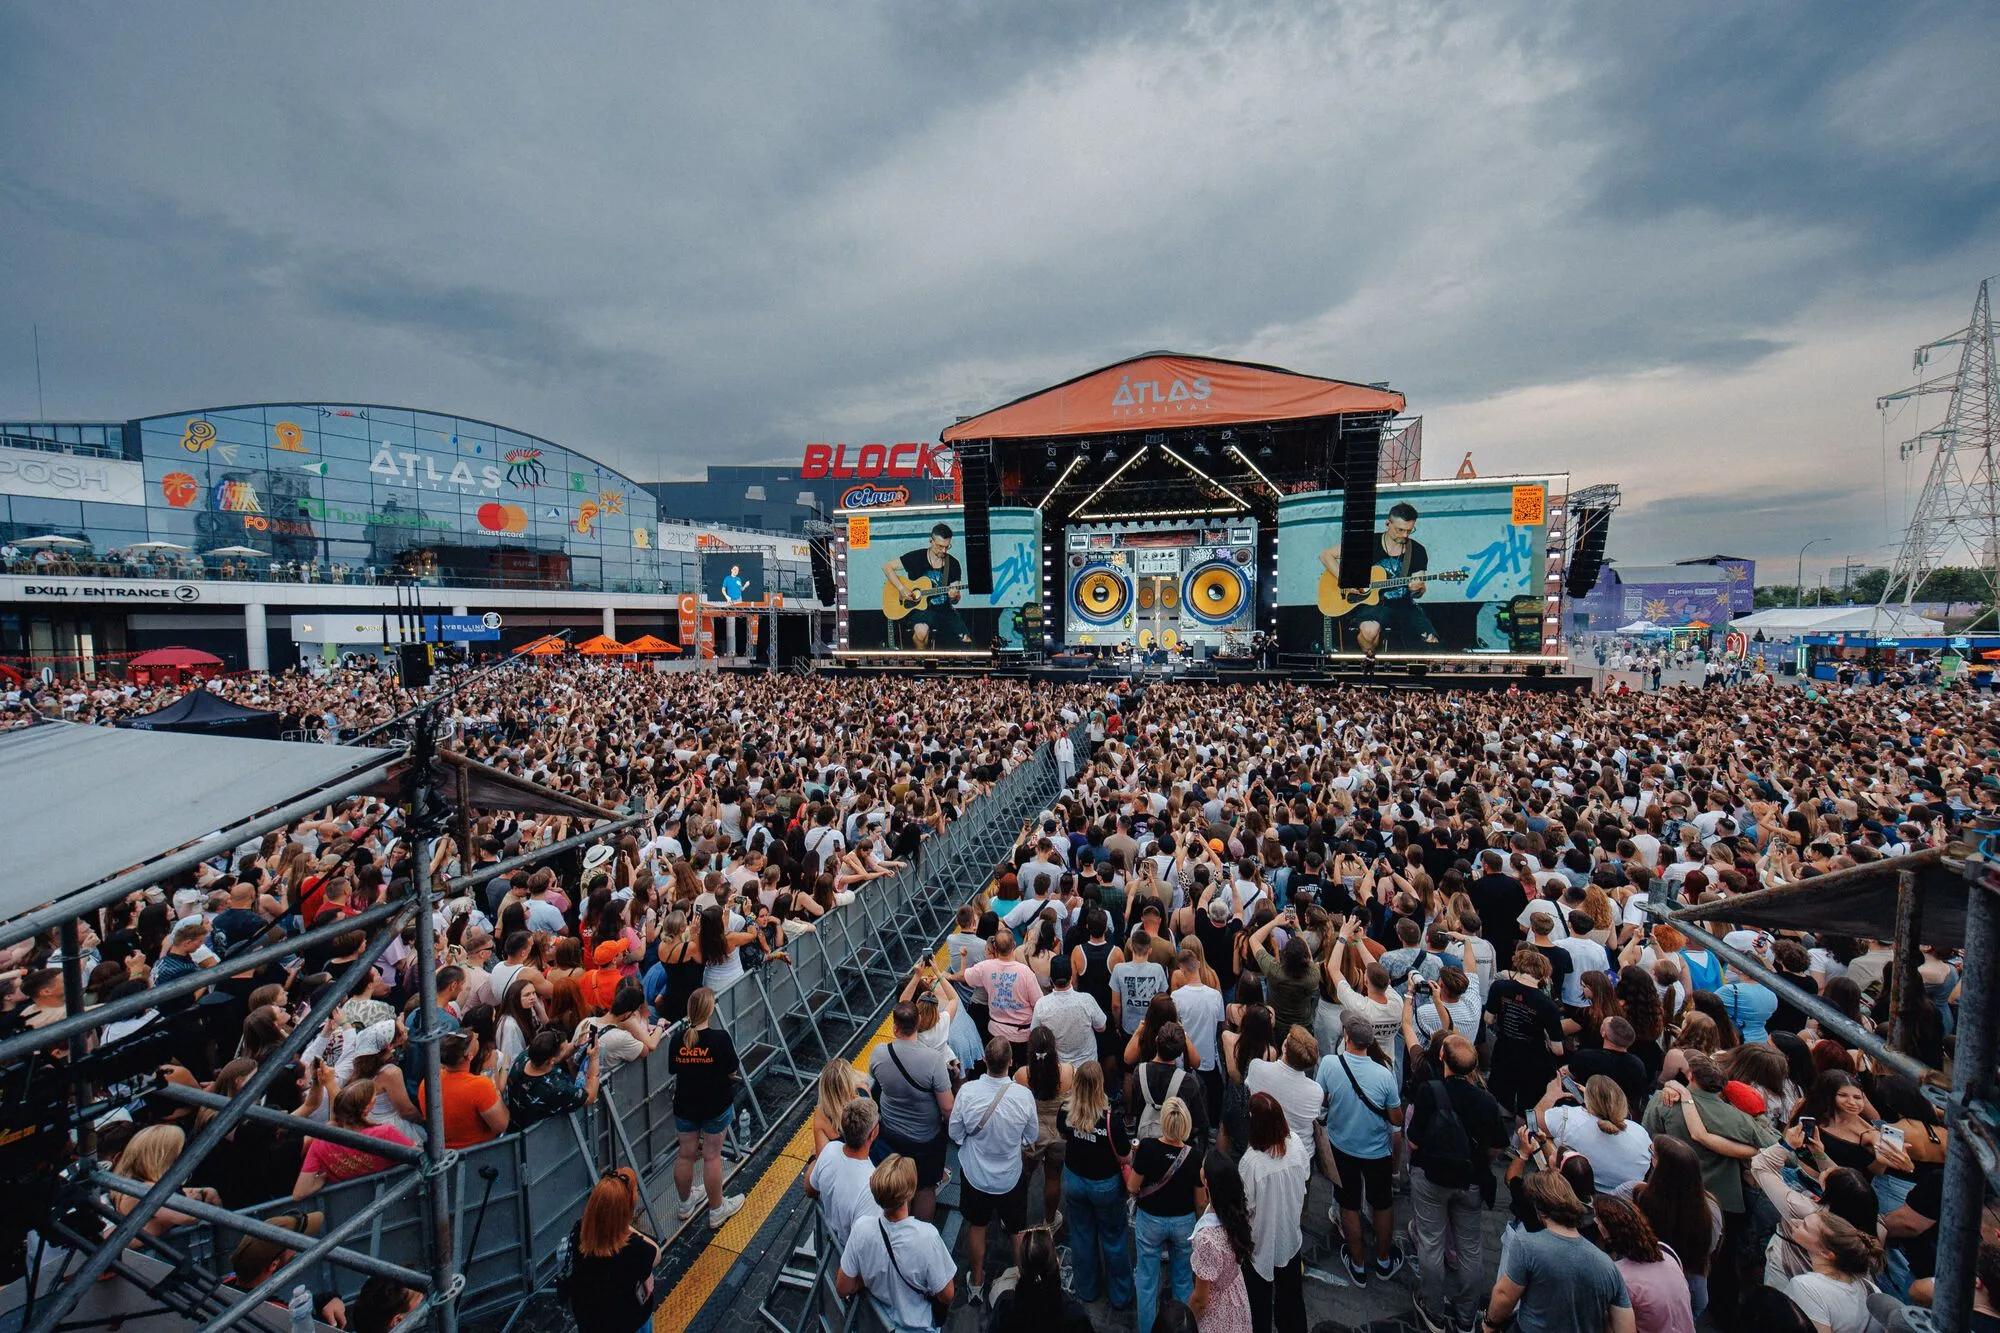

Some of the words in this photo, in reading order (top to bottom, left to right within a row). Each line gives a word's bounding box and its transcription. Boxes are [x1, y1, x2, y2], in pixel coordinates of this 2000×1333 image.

[1113, 403, 1212, 415] FESTIVAL
[801, 443, 961, 479] BLOCK
[385, 478, 500, 498] FESTIVAL
[477, 529, 524, 539] mastercard
[25, 586, 68, 597] ВХІД
[83, 587, 170, 598] ENTRANCE
[679, 1046, 709, 1057] CREW
